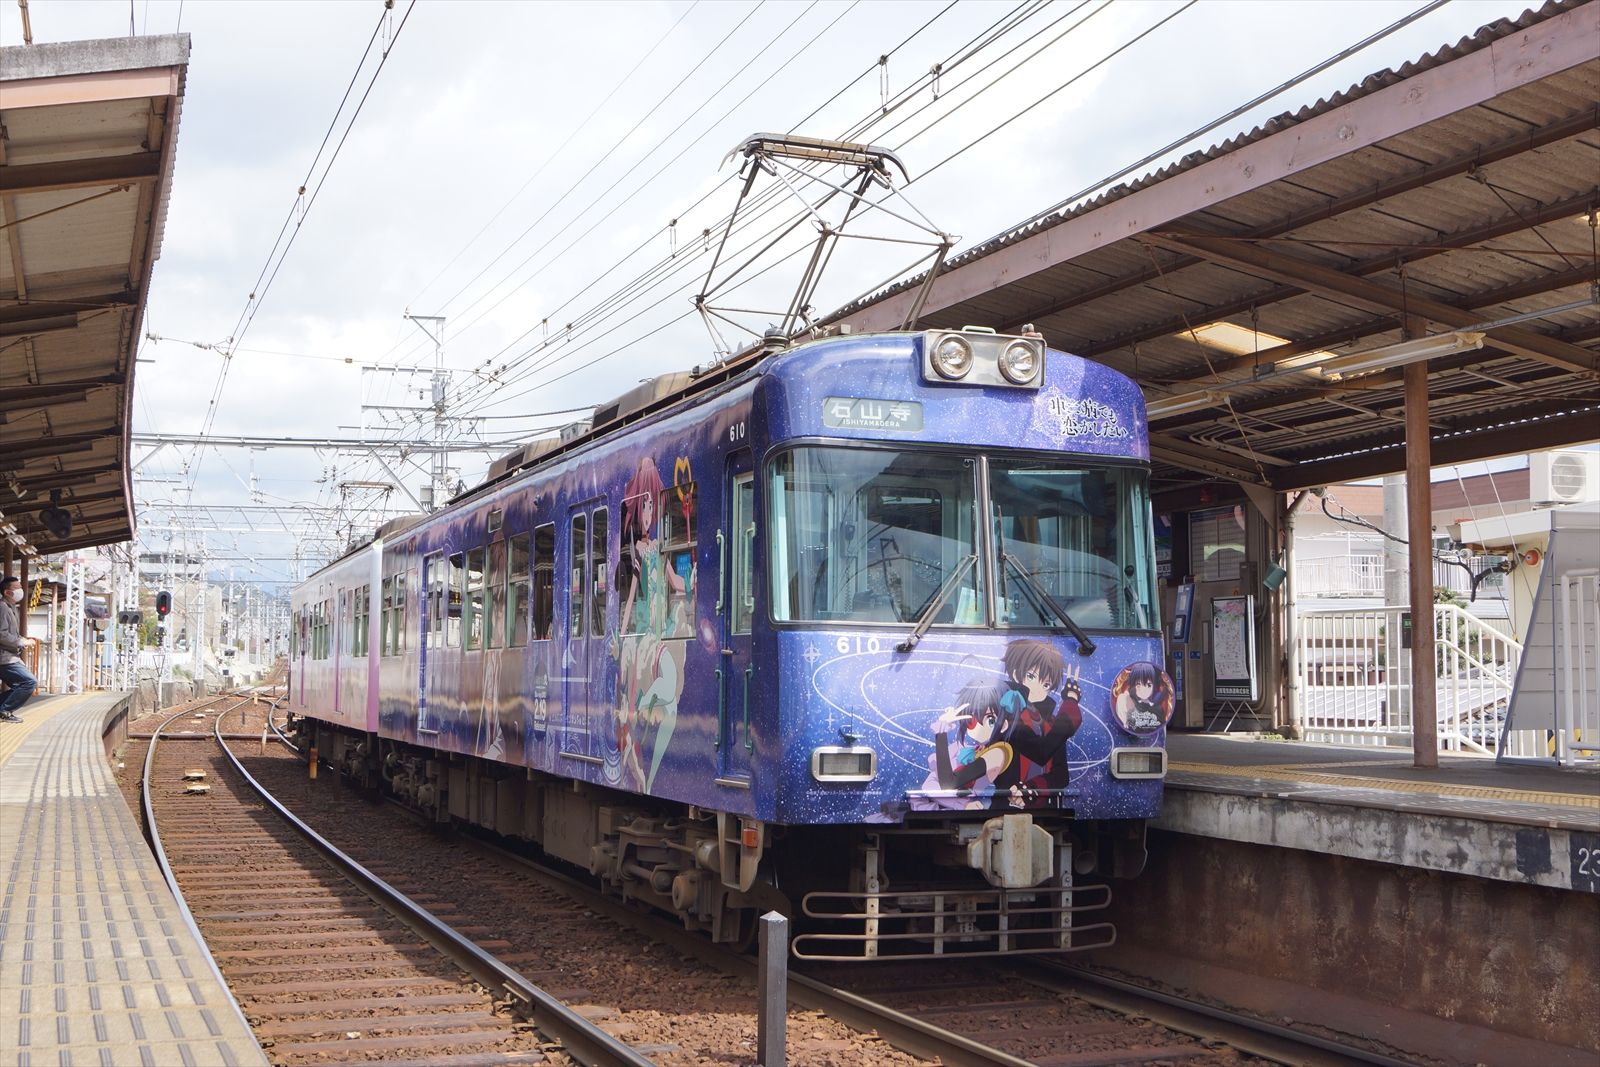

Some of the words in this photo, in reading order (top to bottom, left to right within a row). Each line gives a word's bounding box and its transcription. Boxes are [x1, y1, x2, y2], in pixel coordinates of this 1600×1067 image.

[831, 401, 911, 421] 石山寺
[730, 421, 745, 442] 610
[843, 418, 901, 427] ISHIYAMADERA
[836, 636, 880, 654] 610
